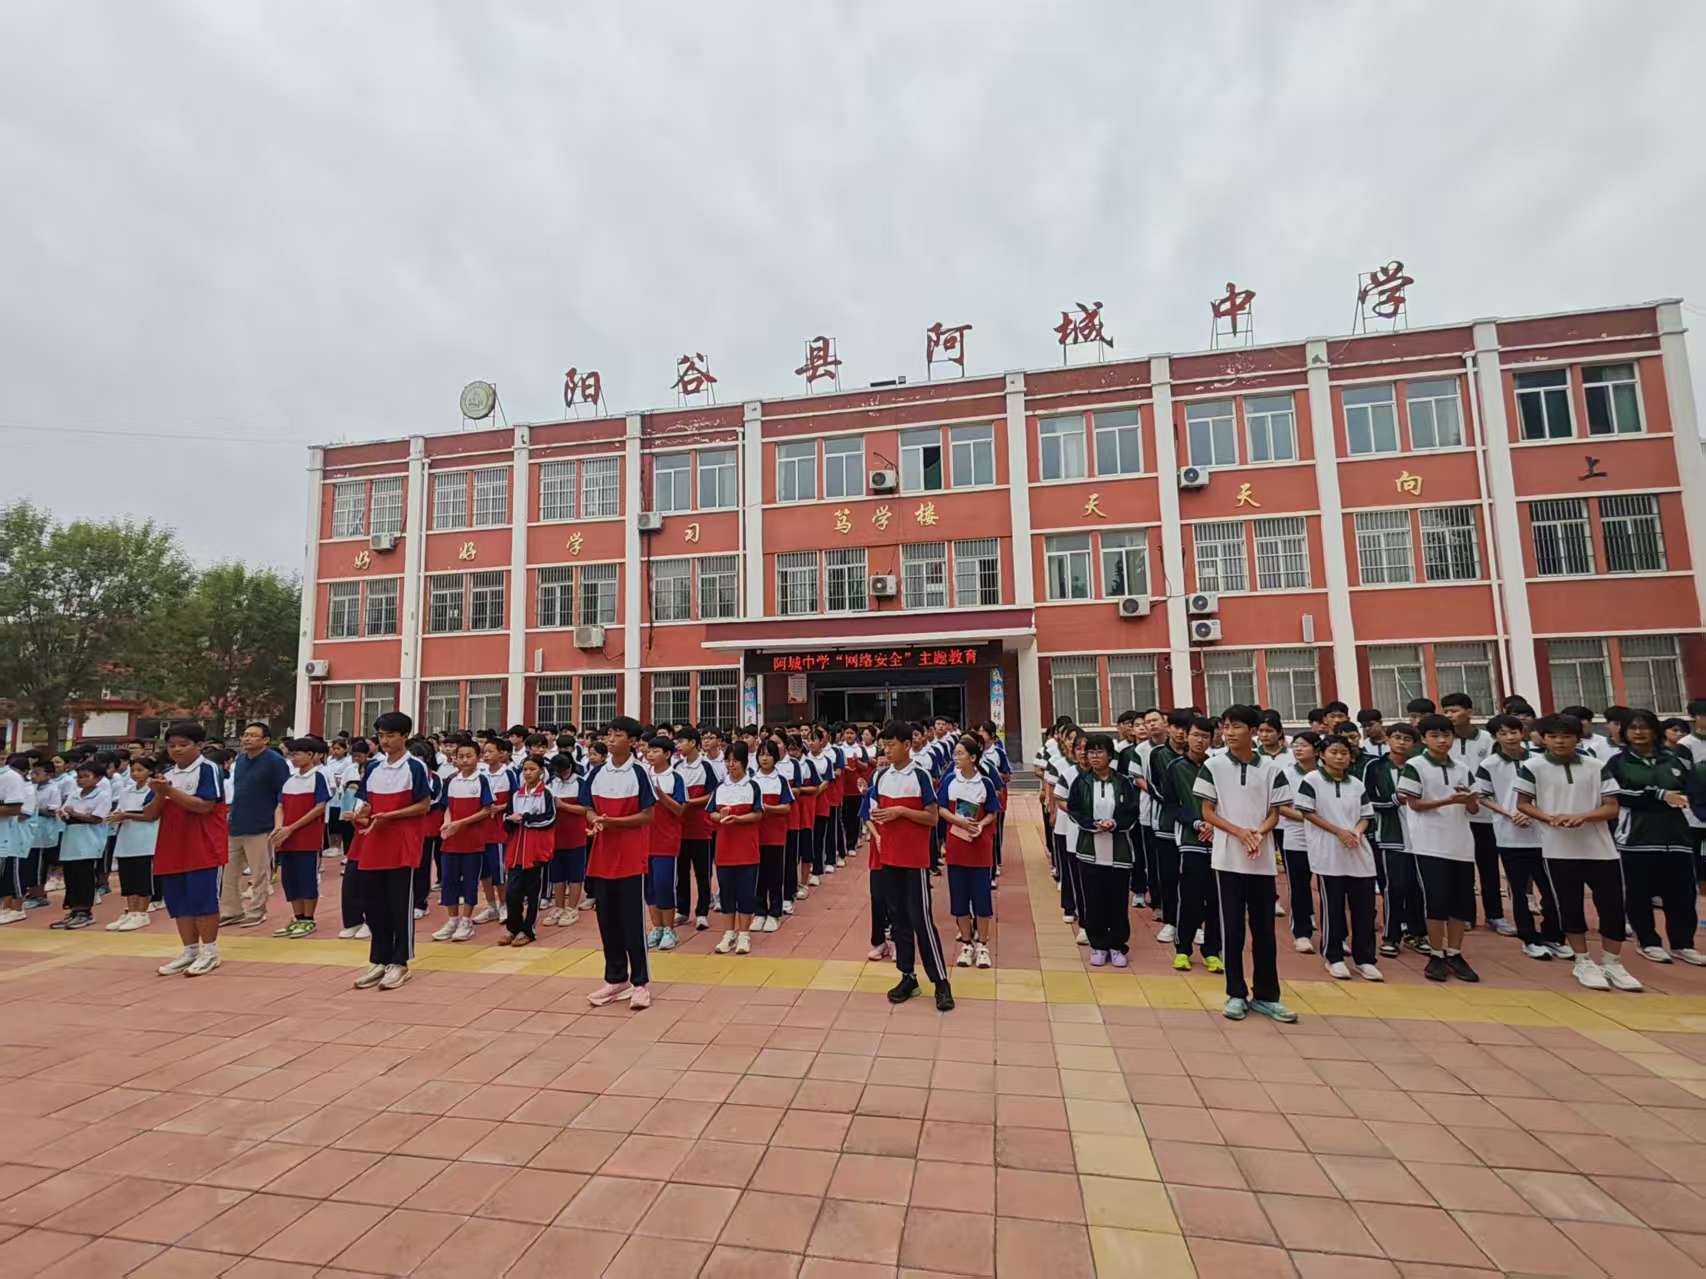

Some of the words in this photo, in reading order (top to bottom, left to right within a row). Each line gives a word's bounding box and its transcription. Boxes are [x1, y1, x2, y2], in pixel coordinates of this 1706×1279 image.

[564, 260, 1414, 408] 阳谷县阿城中学
[1082, 456, 1608, 518] 天天向上
[833, 501, 940, 534] 笃学楼
[352, 521, 701, 570] 好好学习
